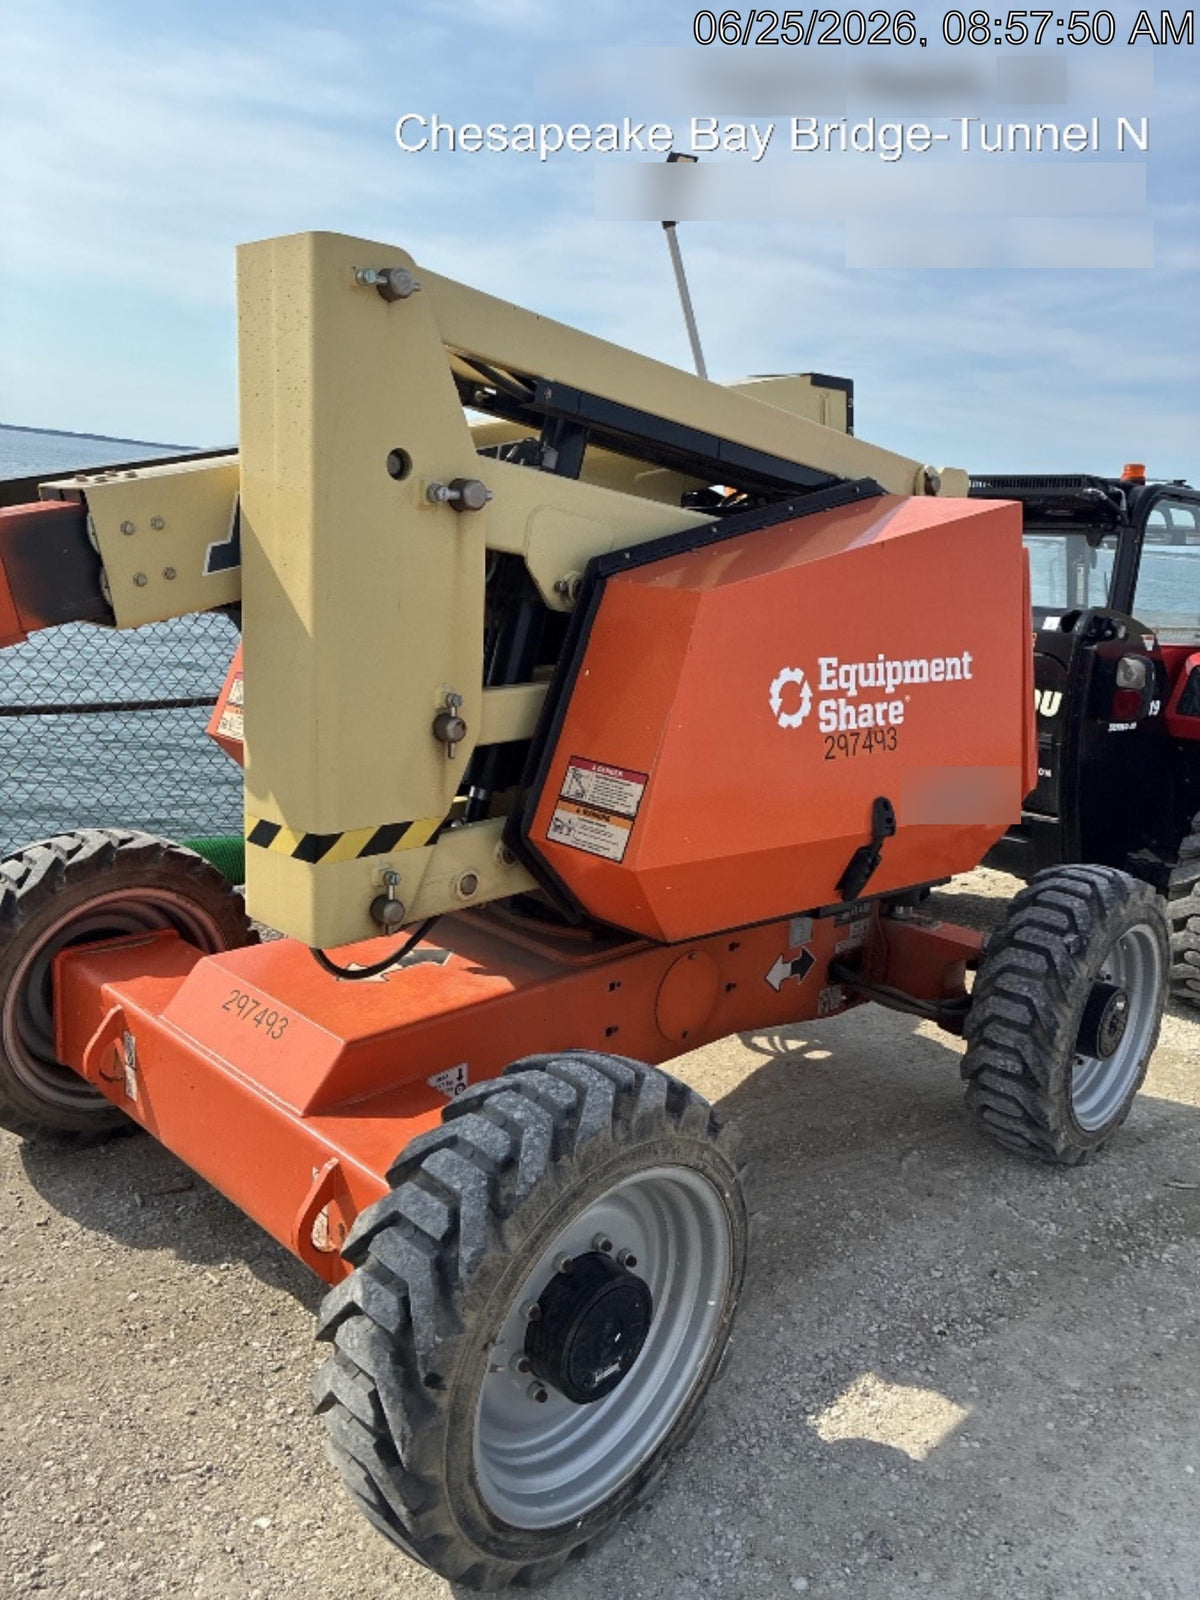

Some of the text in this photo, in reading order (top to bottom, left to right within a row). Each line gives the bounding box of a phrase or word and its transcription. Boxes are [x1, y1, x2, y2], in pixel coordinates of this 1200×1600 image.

[817, 650, 973, 697] Equipment
[818, 698, 904, 733] Share
[1034, 688, 1063, 717] U
[823, 726, 898, 761] 297493
[221, 989, 289, 1040] 297493
